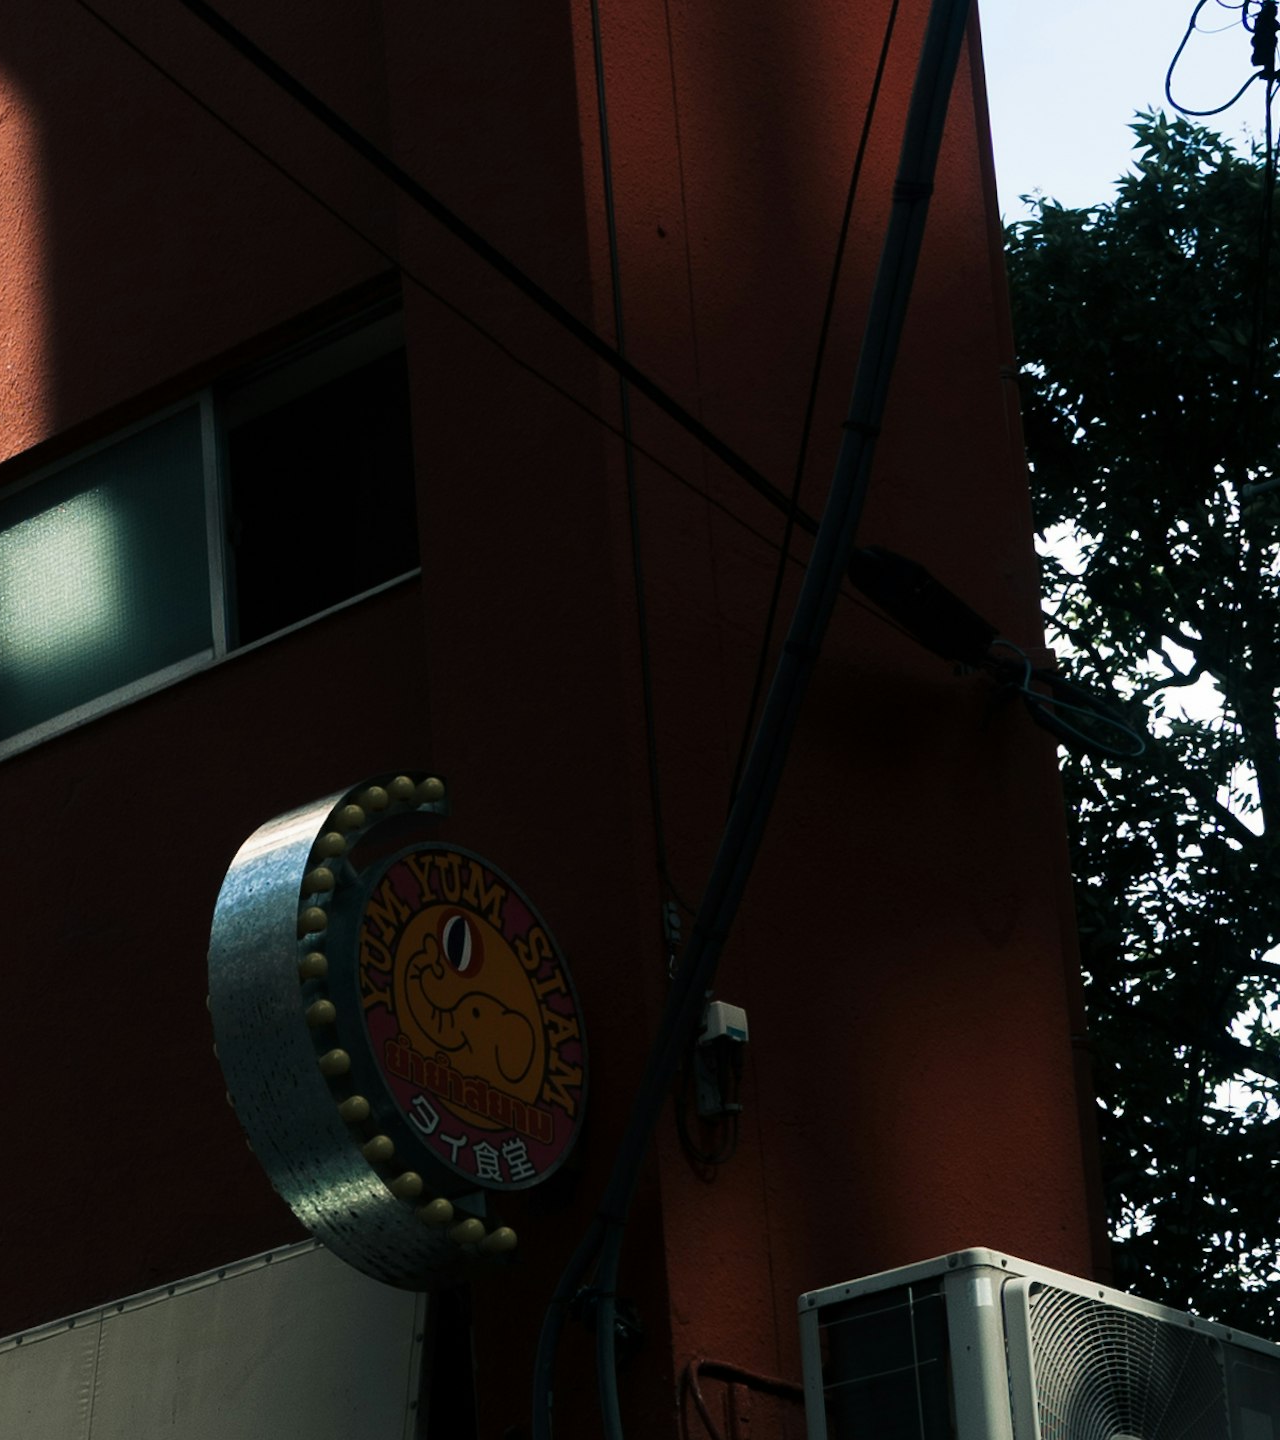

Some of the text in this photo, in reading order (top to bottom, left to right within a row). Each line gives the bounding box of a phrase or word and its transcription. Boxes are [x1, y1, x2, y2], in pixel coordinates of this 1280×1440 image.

[357, 852, 585, 1119] YUM YUM SIAM
[383, 1033, 555, 1145] ยำยำสยาม
[407, 1094, 537, 1184] タイ食堂
